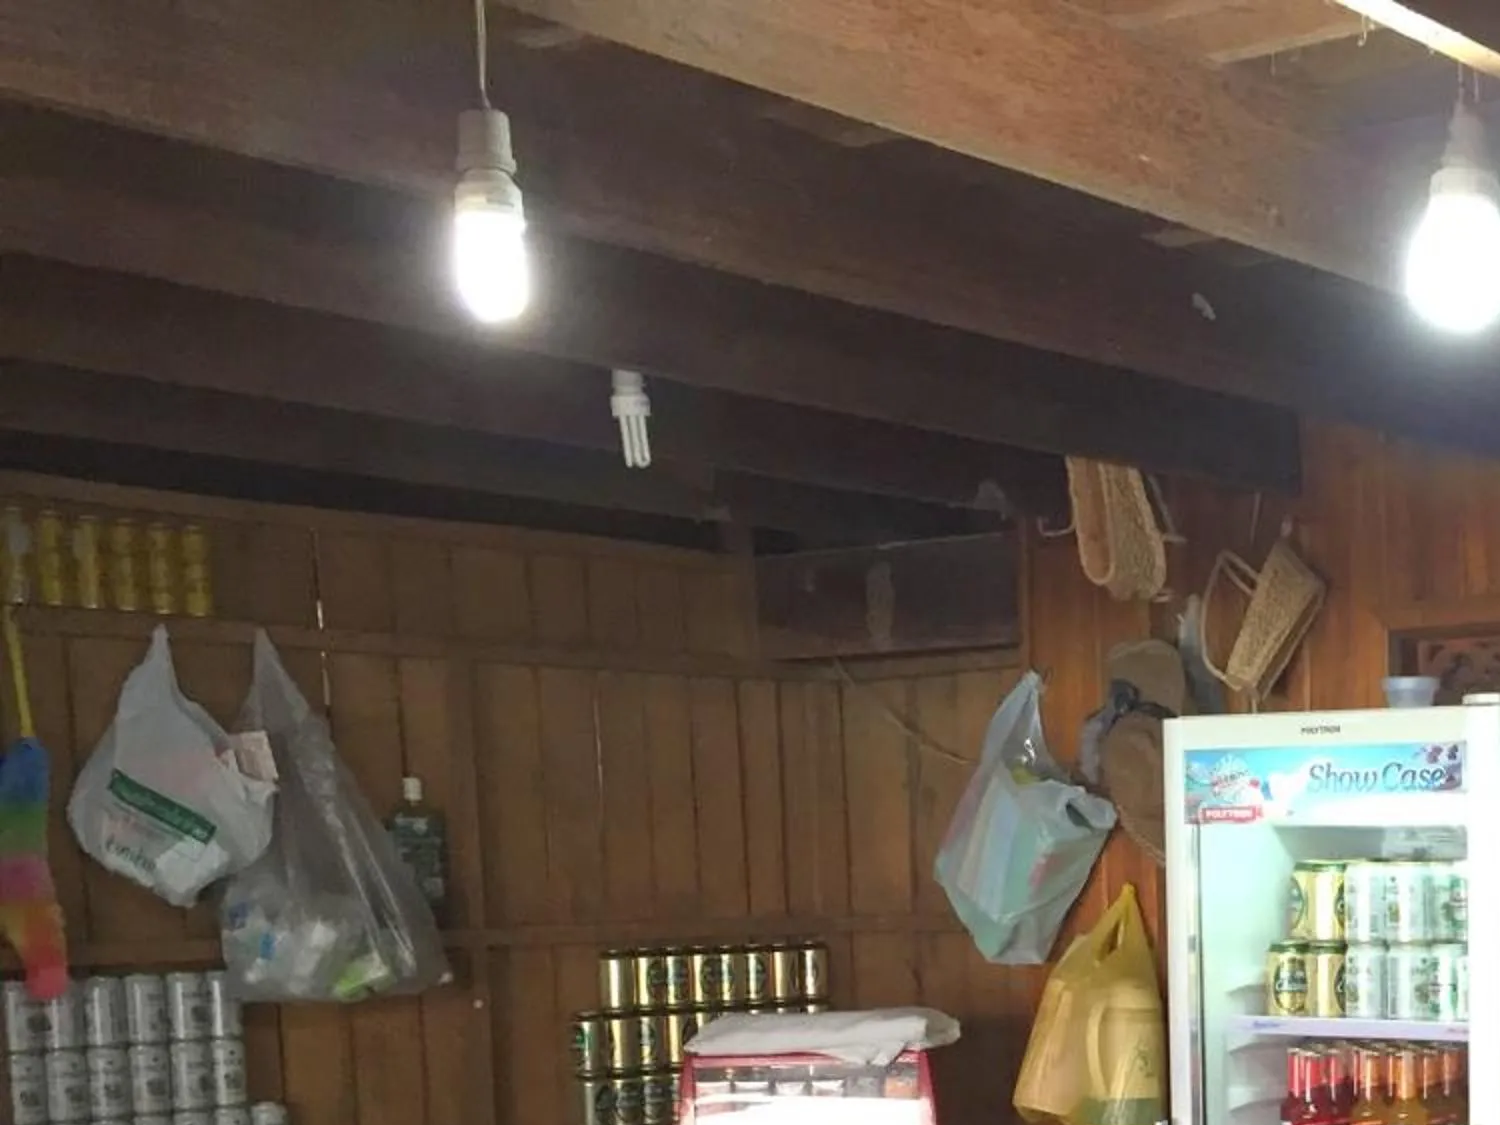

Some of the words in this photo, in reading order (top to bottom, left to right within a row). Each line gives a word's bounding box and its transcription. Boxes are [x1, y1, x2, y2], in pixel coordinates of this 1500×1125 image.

[1300, 725, 1341, 735] POLYTRON
[1308, 763, 1378, 793] Show
[1381, 761, 1446, 792] Case
